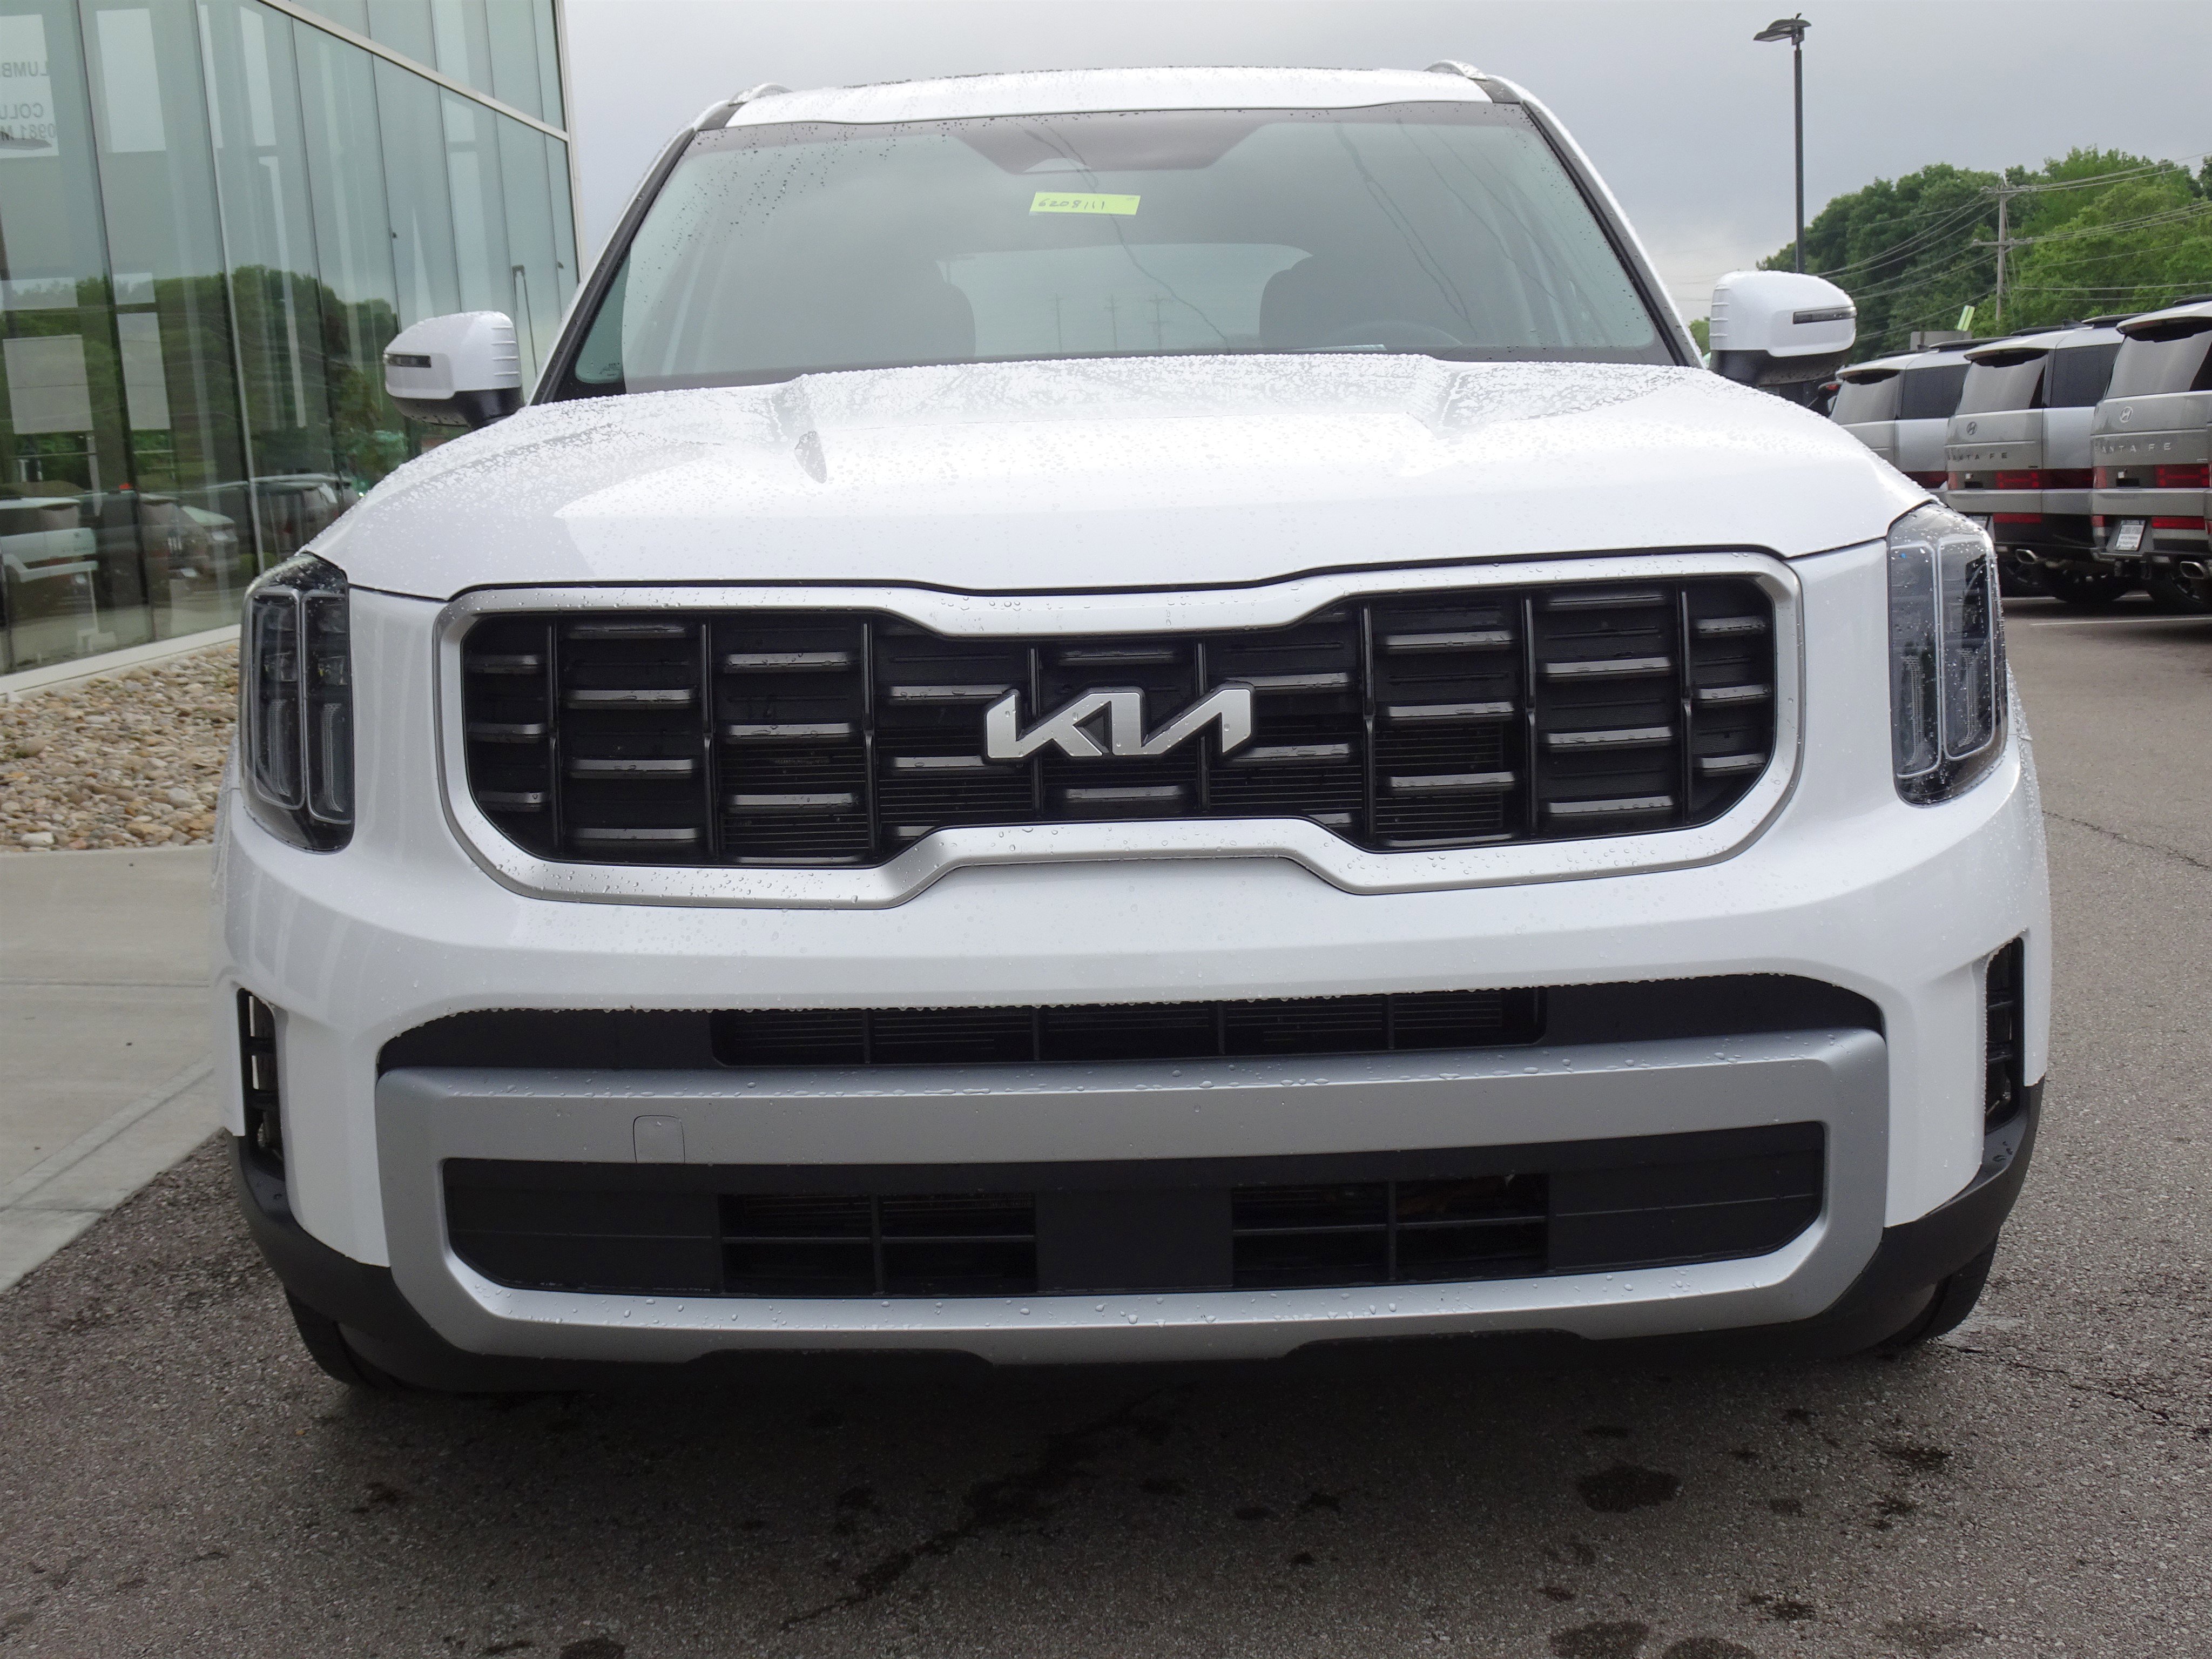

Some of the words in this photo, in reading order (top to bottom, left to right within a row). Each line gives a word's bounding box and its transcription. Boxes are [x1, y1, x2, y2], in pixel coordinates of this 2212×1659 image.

[1038, 198, 1105, 210] 6208111
[2148, 442, 2171, 451] FE
[986, 689, 1252, 759] KIA
